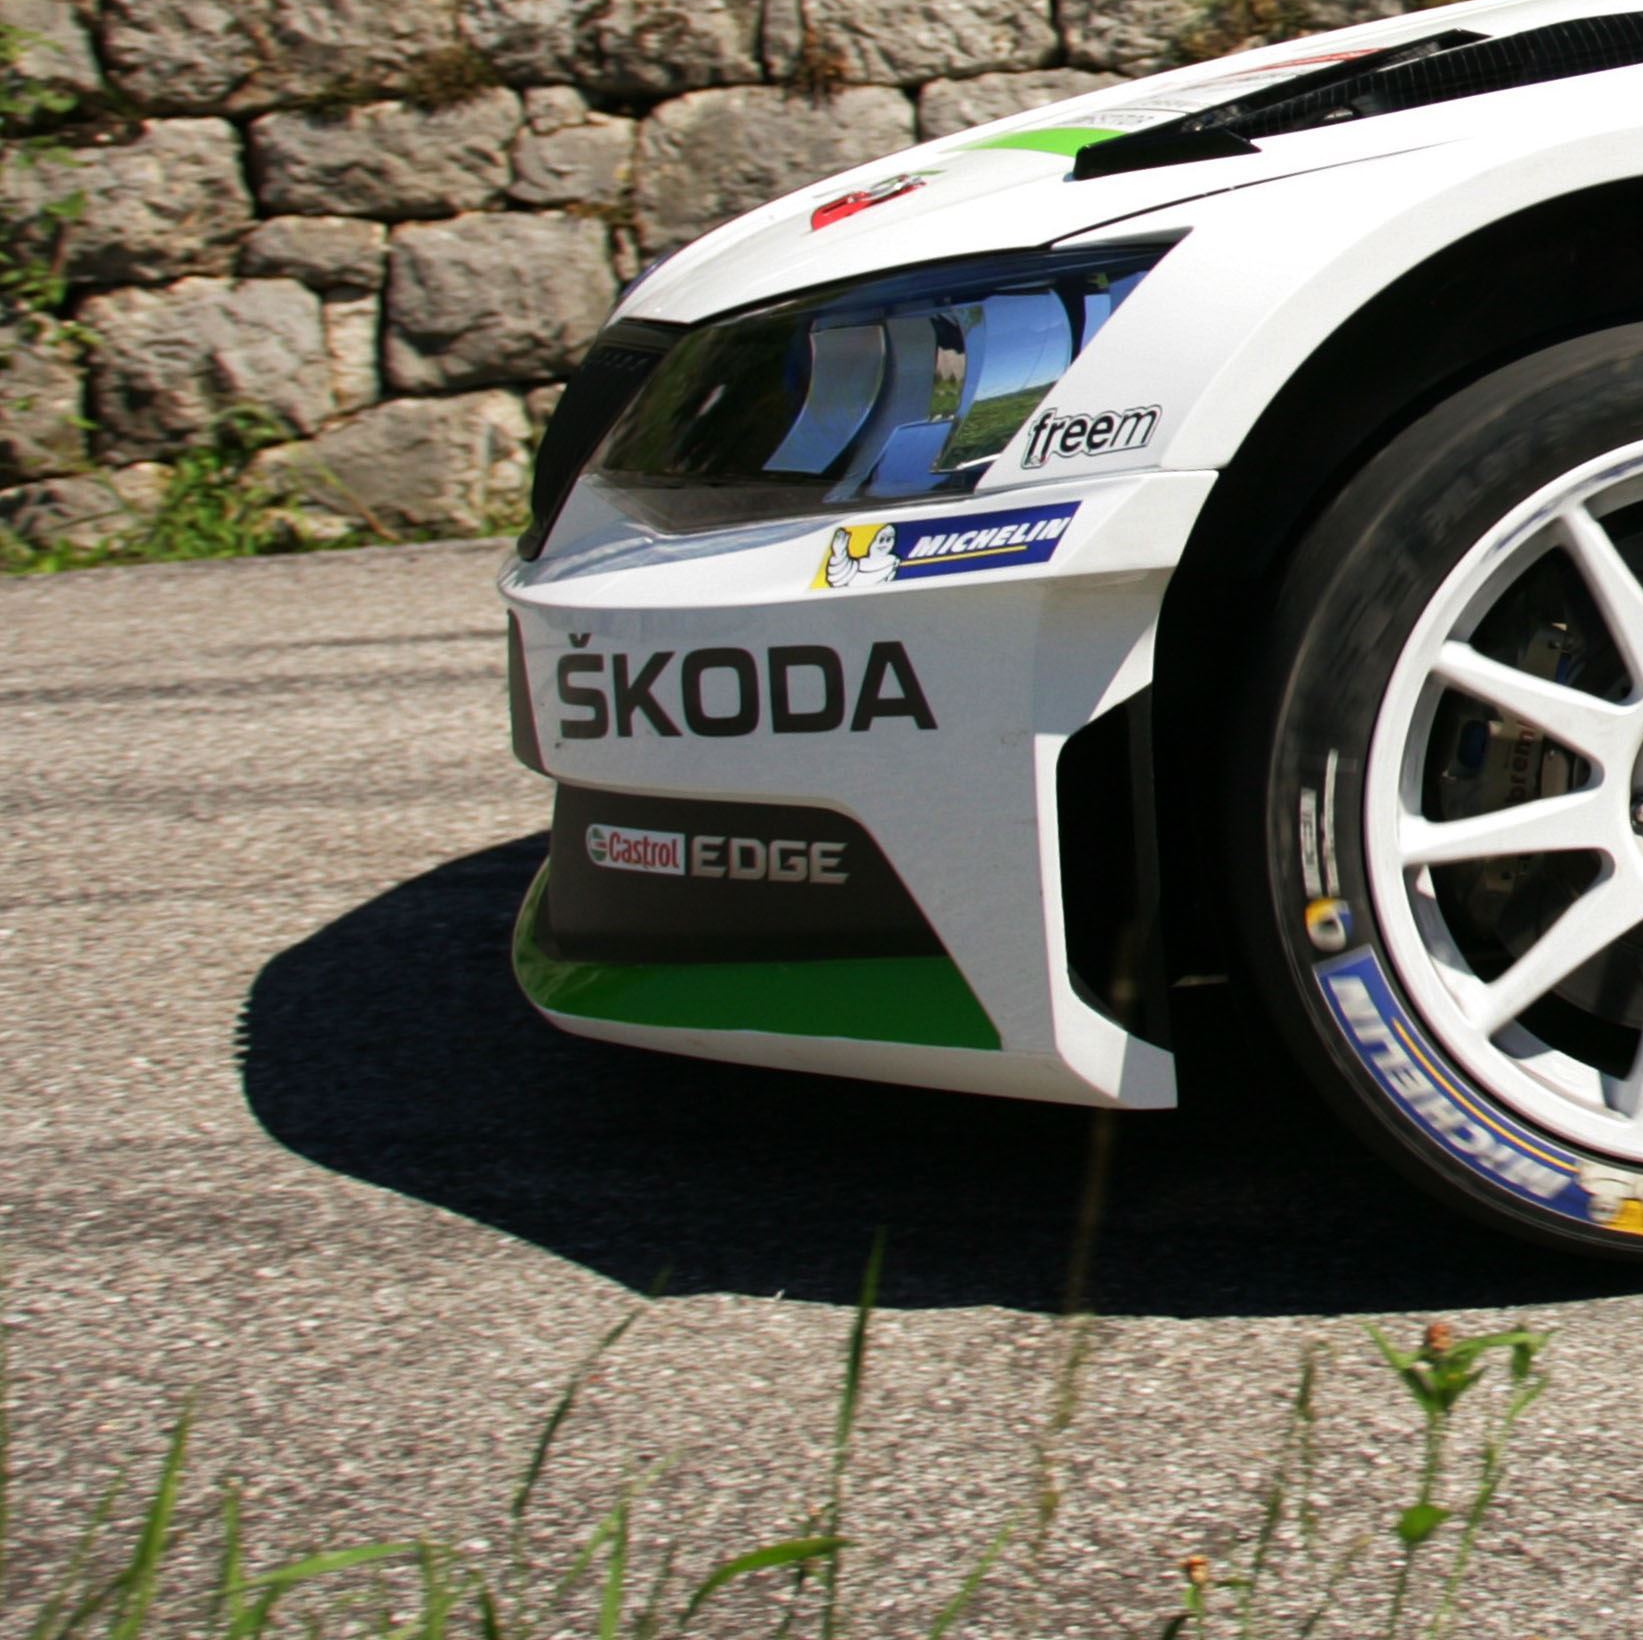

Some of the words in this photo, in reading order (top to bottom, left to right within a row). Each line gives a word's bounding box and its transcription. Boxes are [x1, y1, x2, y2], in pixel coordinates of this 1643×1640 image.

[1027, 406, 1157, 466] freem
[908, 516, 1071, 558] MICHELIN
[556, 633, 938, 740] ŠKODA
[608, 831, 681, 870] Castrol
[691, 835, 849, 884] EDGE
